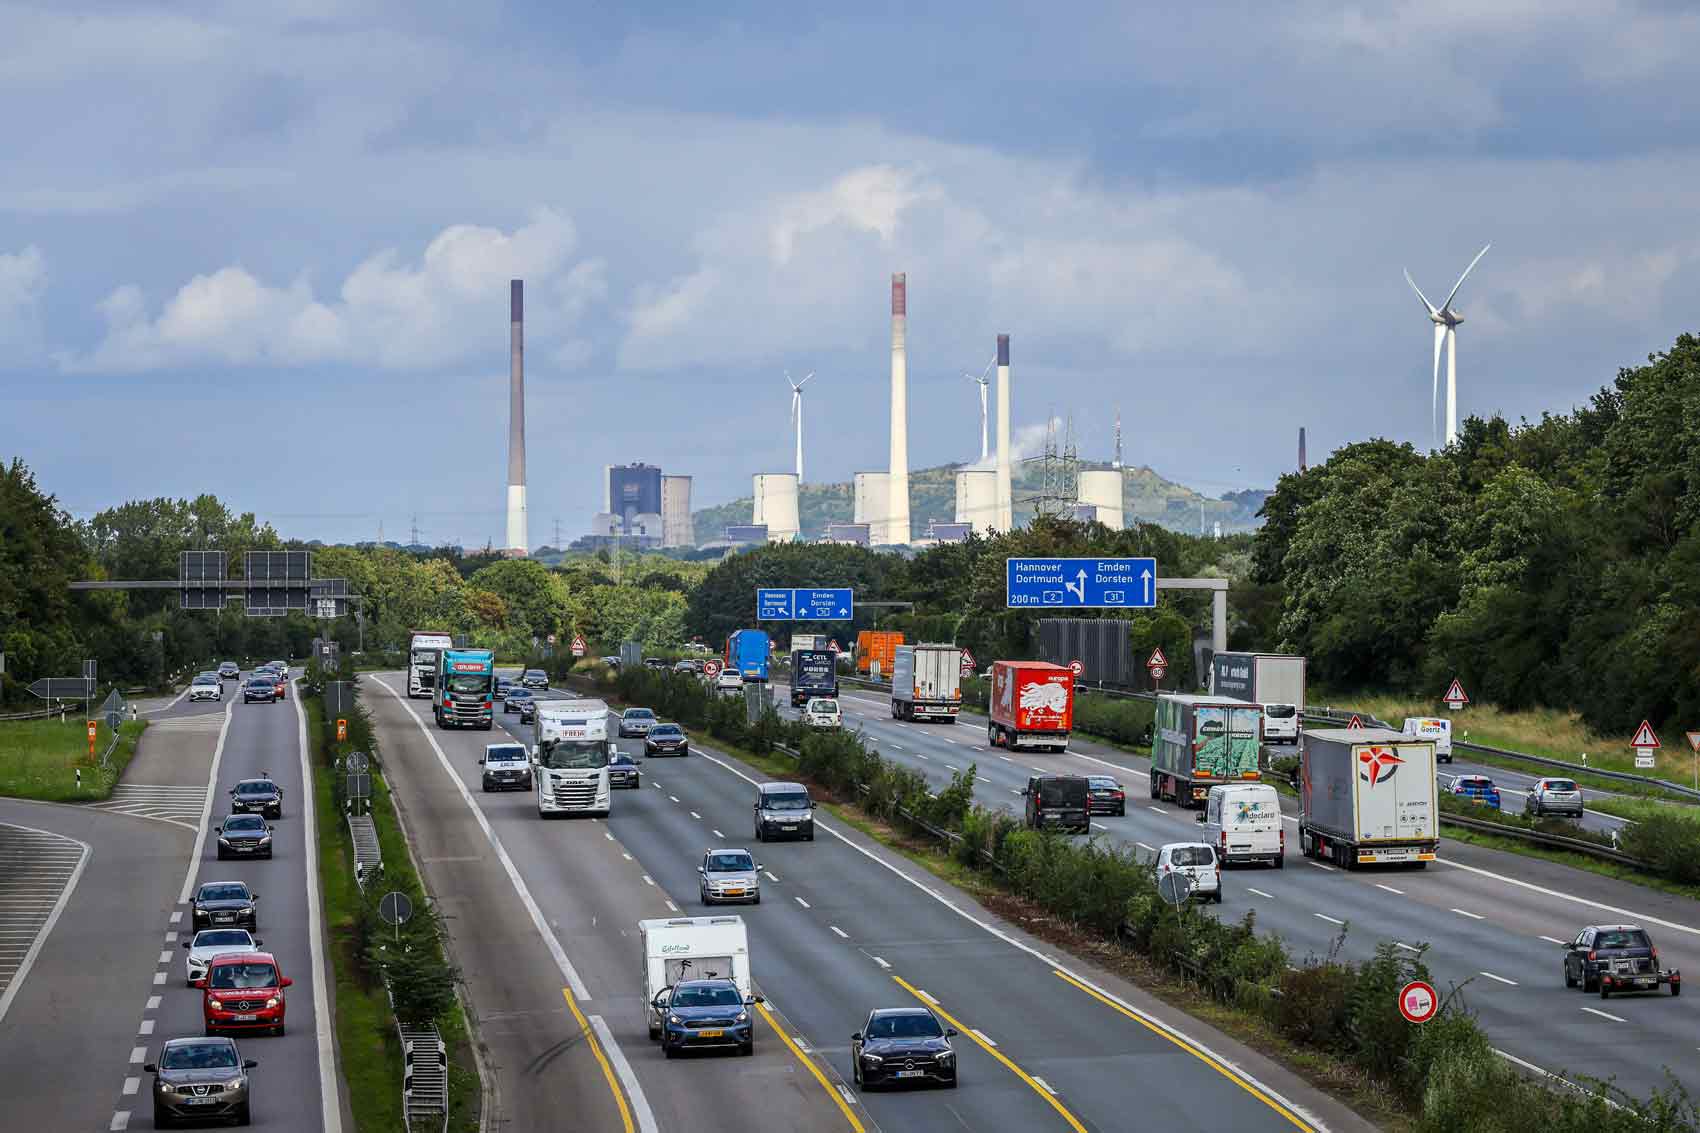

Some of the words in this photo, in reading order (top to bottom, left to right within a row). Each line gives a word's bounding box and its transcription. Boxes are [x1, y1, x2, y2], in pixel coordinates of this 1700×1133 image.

[1016, 562, 1062, 571] Hannover
[1097, 562, 1131, 571] Emden
[1016, 574, 1063, 583] Dortmund
[1095, 574, 1133, 583] Dorsten
[1011, 595, 1029, 603] 200
[1110, 593, 1119, 601] 31
